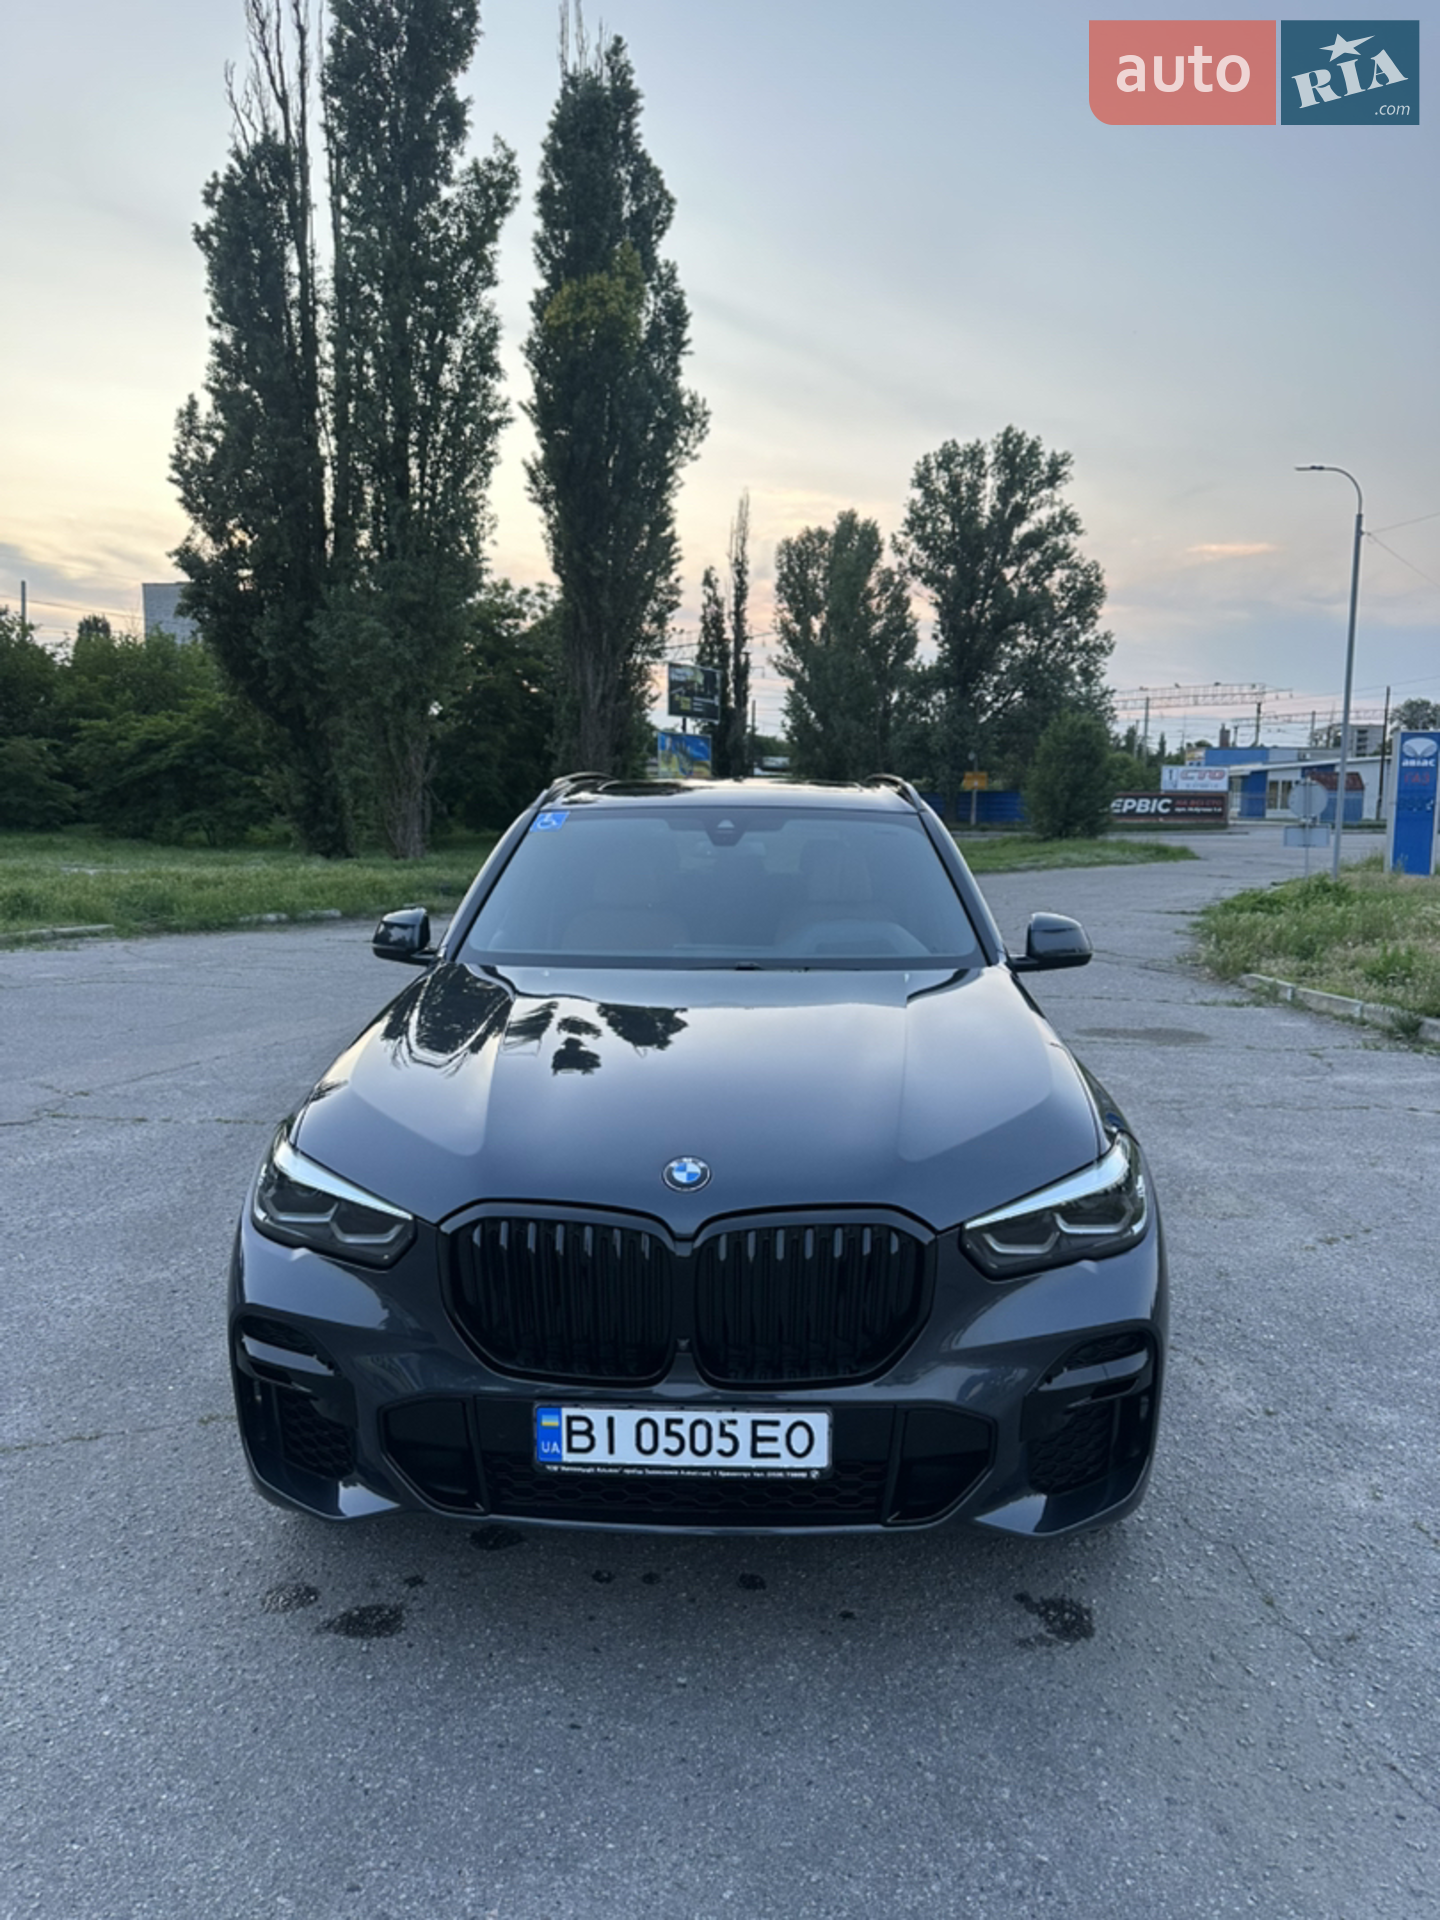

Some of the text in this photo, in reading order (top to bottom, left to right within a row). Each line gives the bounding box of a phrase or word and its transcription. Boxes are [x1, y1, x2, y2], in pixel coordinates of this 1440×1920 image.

[1110, 797, 1172, 814] ЕРВІС
[565, 1415, 615, 1455] BI
[541, 1440, 561, 1455] UA
